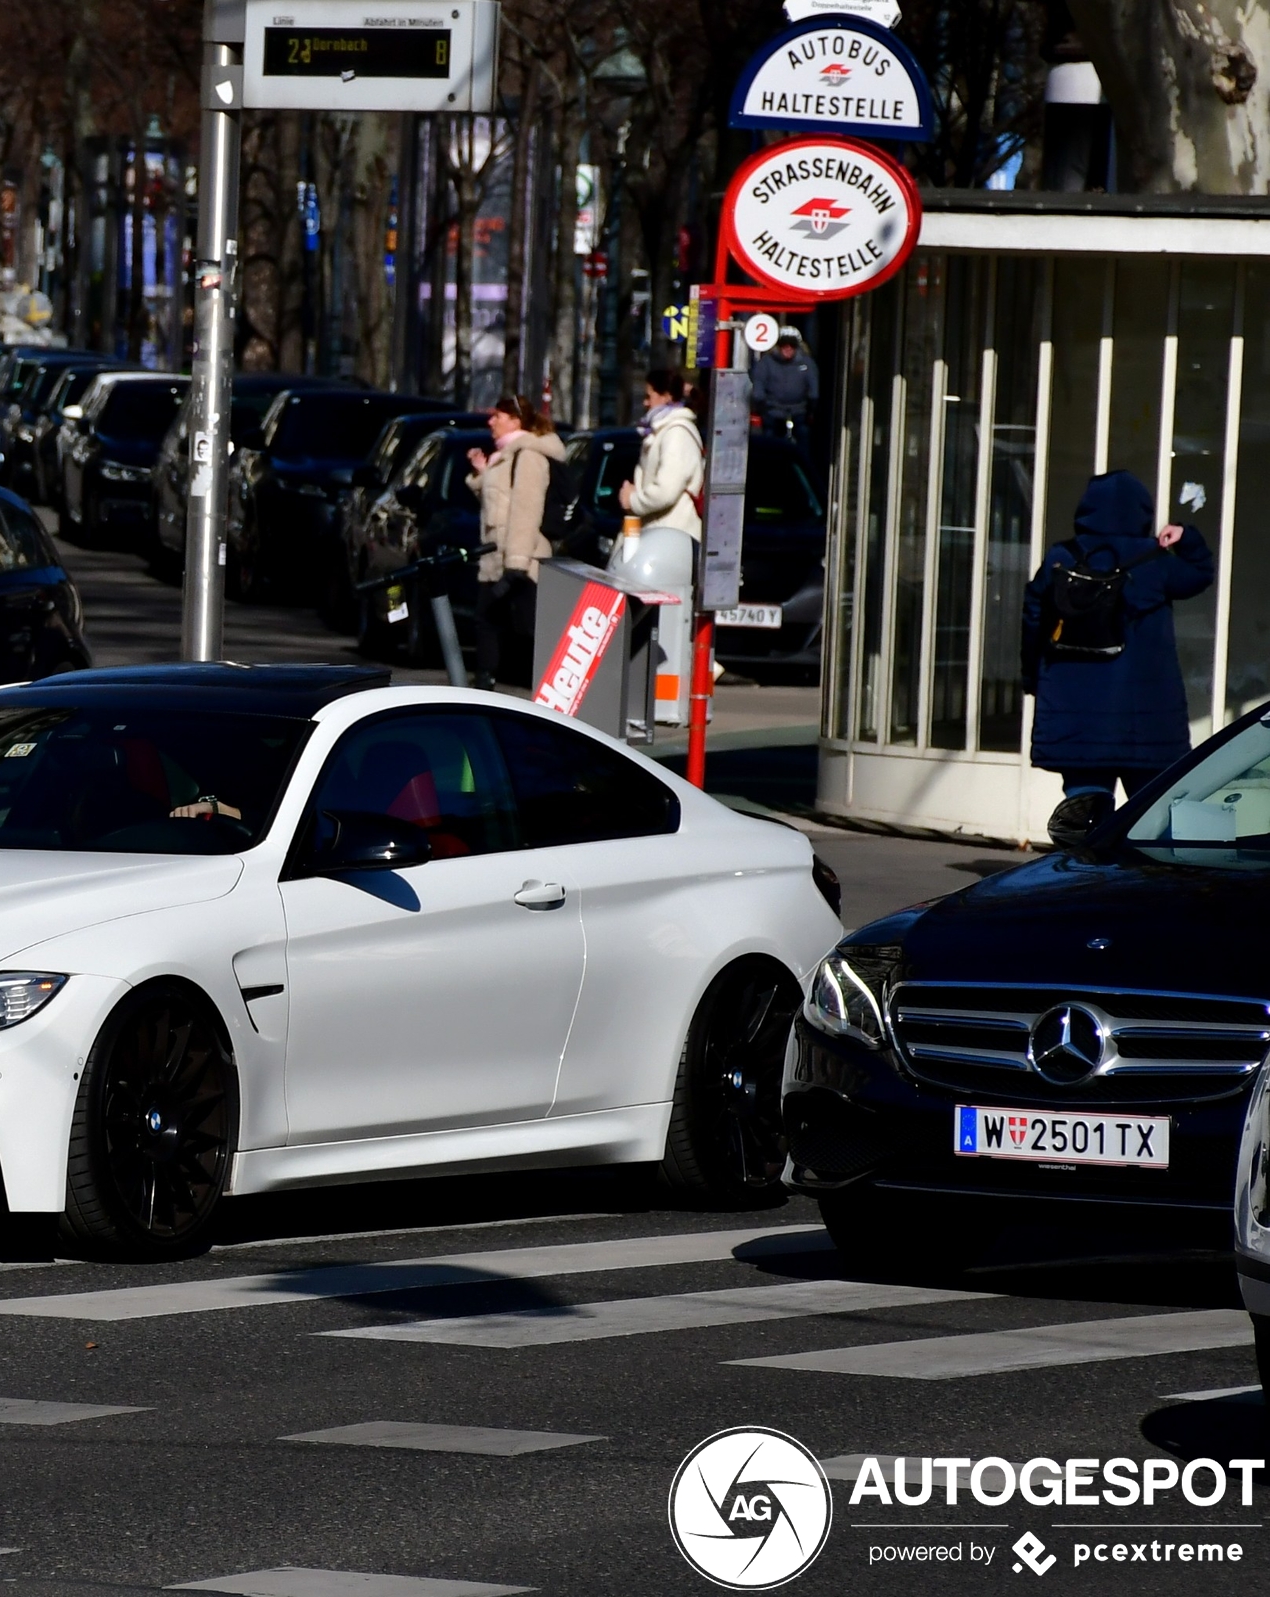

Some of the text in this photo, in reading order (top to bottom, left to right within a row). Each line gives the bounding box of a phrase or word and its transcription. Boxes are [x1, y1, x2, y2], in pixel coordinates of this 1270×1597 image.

[273, 16, 295, 26] Linie
[364, 17, 444, 28] Abfahrt in Minuten
[313, 38, 368, 52] Dornbach
[435, 40, 447, 65] 8
[787, 36, 891, 76] AUTOBUS
[762, 91, 904, 120] HALTESTELLE
[752, 157, 896, 215] STRASSENBAHN
[752, 229, 883, 279] HALTESTELLE
[755, 323, 768, 342] 2
[535, 606, 609, 715] Heute
[964, 1135, 972, 1145] A
[984, 1115, 1155, 1158] W 2501 TX
